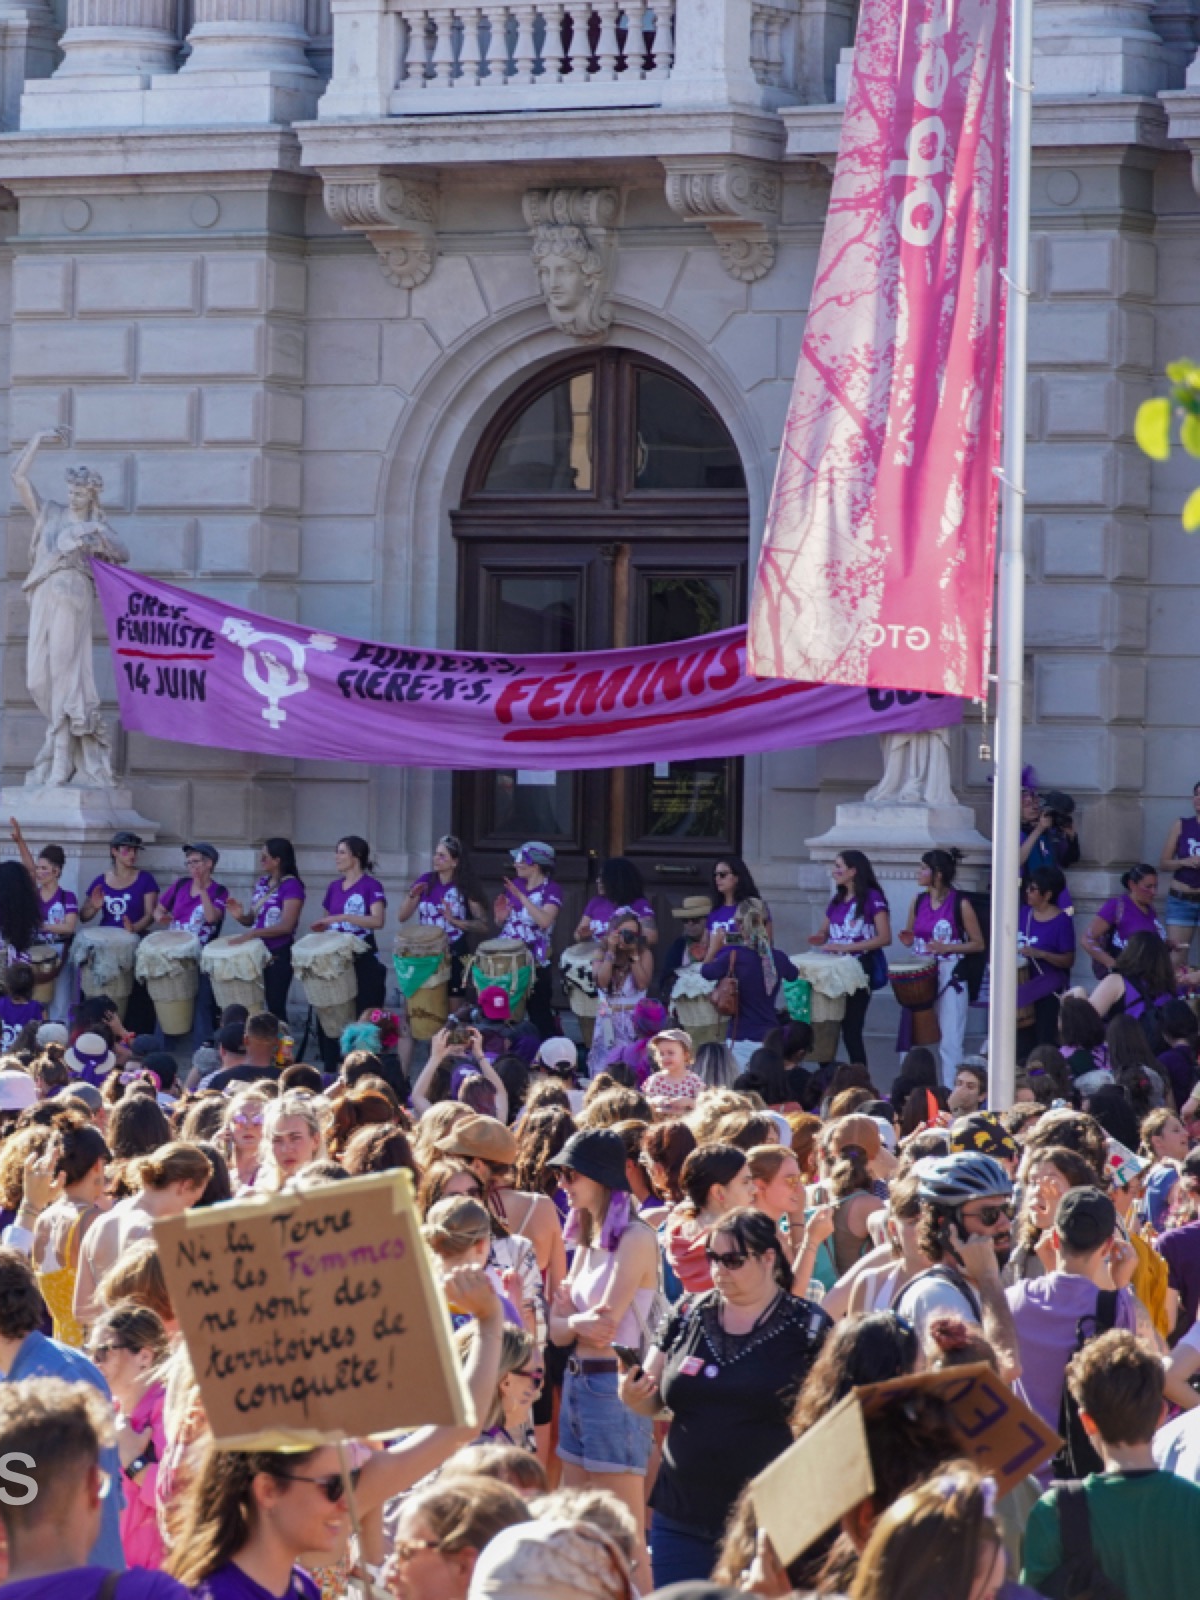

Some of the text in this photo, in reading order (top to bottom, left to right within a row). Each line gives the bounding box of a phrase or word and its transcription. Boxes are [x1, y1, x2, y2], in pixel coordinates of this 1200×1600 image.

[123, 661, 206, 702] 14 JUIN
[494, 639, 766, 724] FÉMINIS
[177, 1207, 353, 1268] Ni la Terre
[187, 1238, 406, 1297] ni les Femmes
[199, 1276, 381, 1333] ne sont des
[205, 1305, 407, 1379] territoires de
